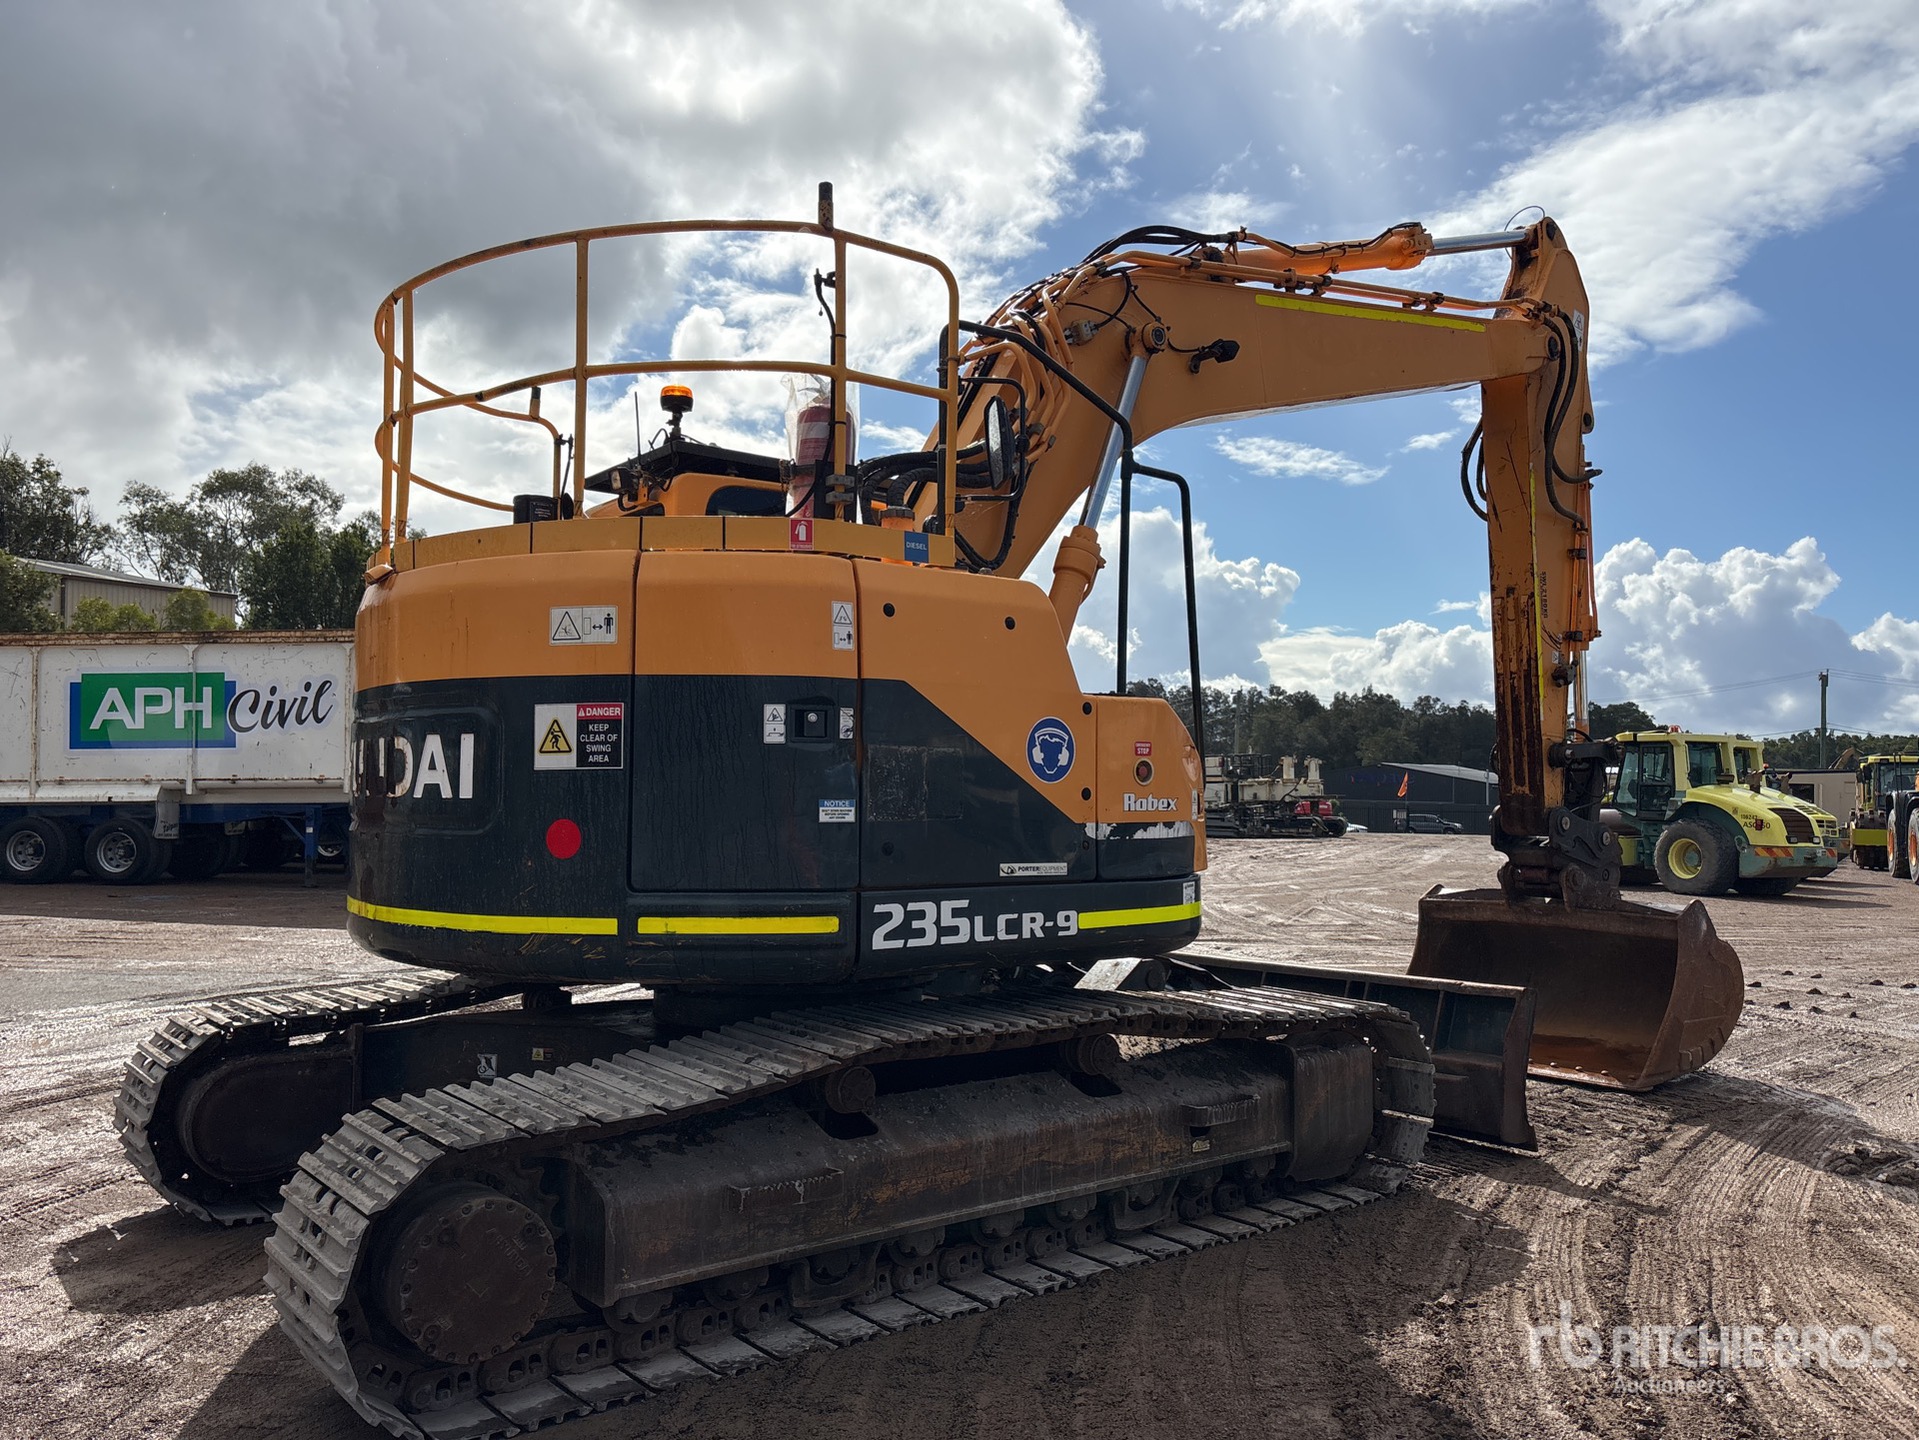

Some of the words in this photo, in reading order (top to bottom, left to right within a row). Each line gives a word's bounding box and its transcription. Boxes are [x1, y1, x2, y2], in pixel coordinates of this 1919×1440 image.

[906, 541, 927, 551] DIESEL
[90, 687, 212, 729] APH
[227, 680, 333, 733] Civil
[586, 707, 621, 716] DANGER
[588, 723, 609, 731] KEEP
[580, 734, 605, 742] CLEAR
[607, 734, 618, 742] OF
[586, 744, 611, 753] SWING
[588, 755, 609, 763] AREA
[1123, 793, 1178, 812] Robex
